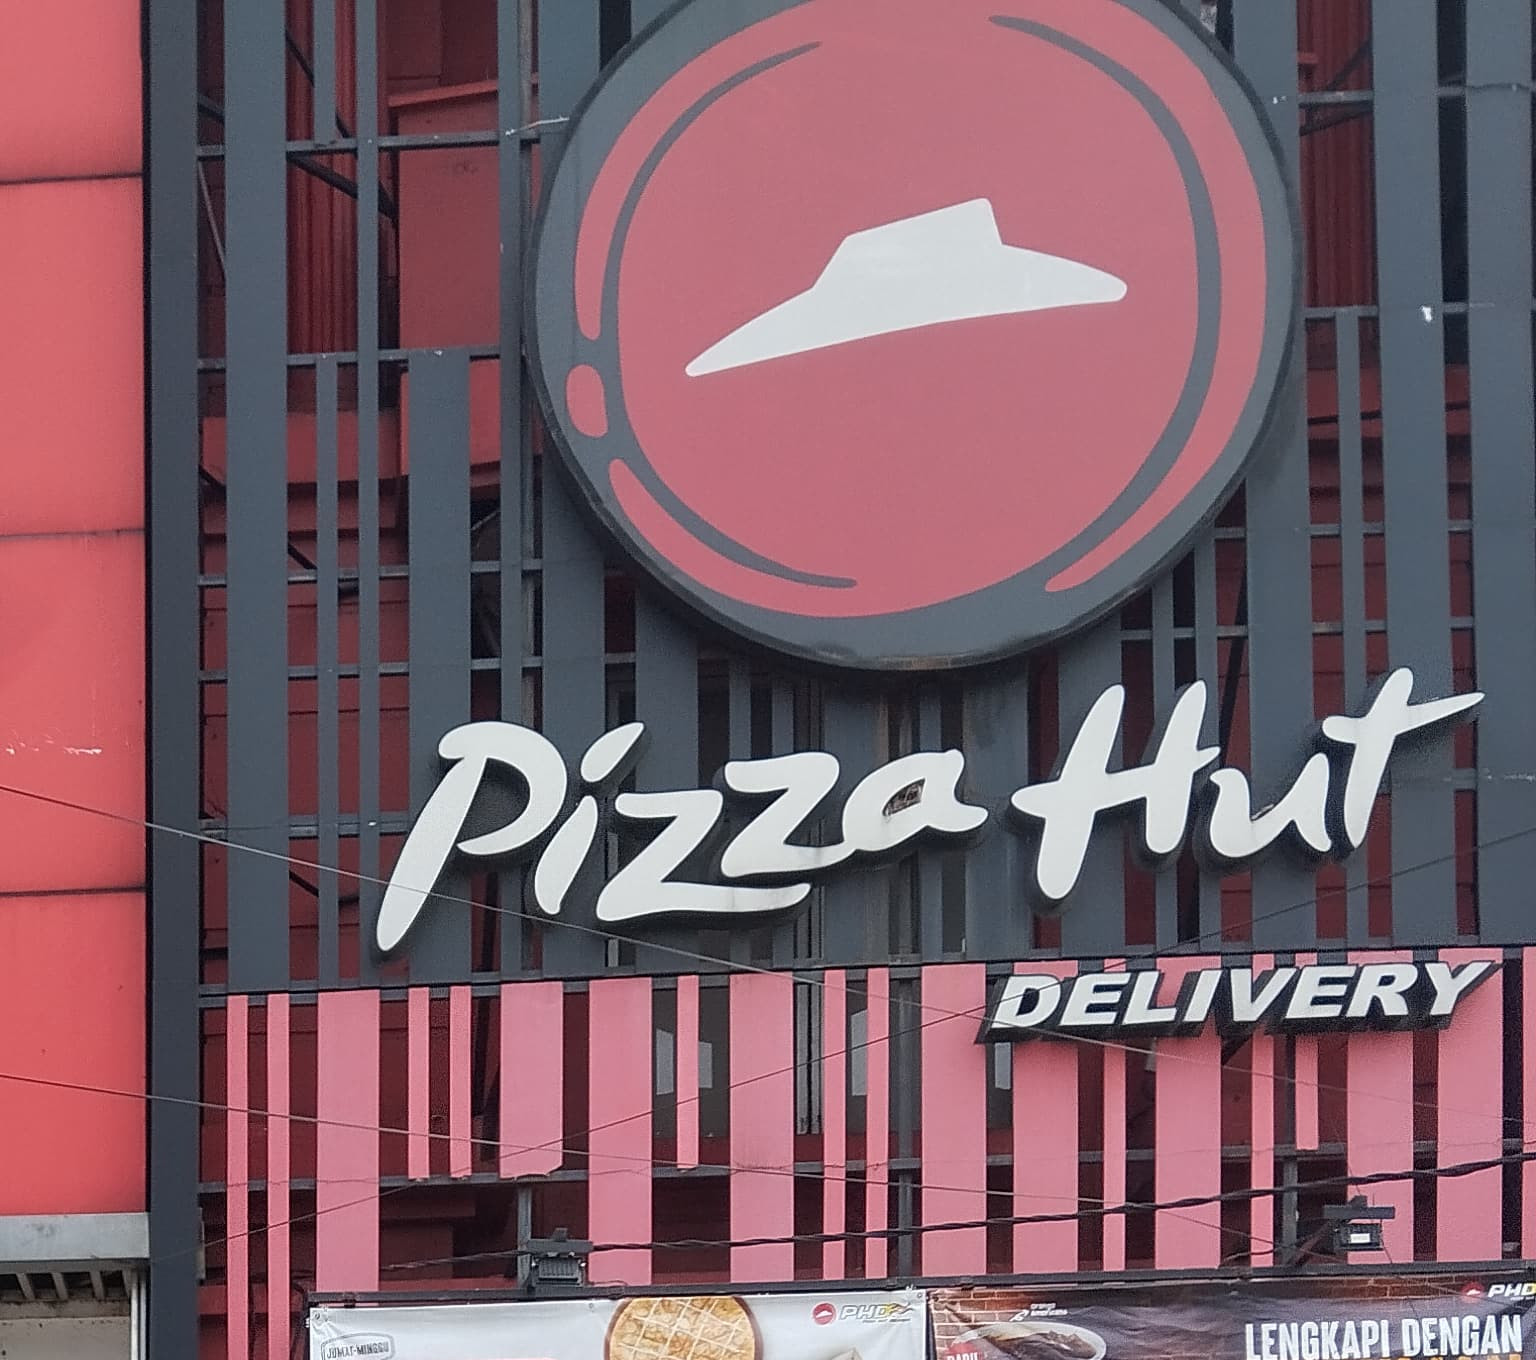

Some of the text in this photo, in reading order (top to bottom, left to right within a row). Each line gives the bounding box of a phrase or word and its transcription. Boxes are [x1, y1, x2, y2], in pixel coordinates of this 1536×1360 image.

[375, 667, 1486, 953] Pizza Hut
[984, 959, 1500, 1036] DELIVERY
[1401, 1313, 1523, 1357] DENGAN
